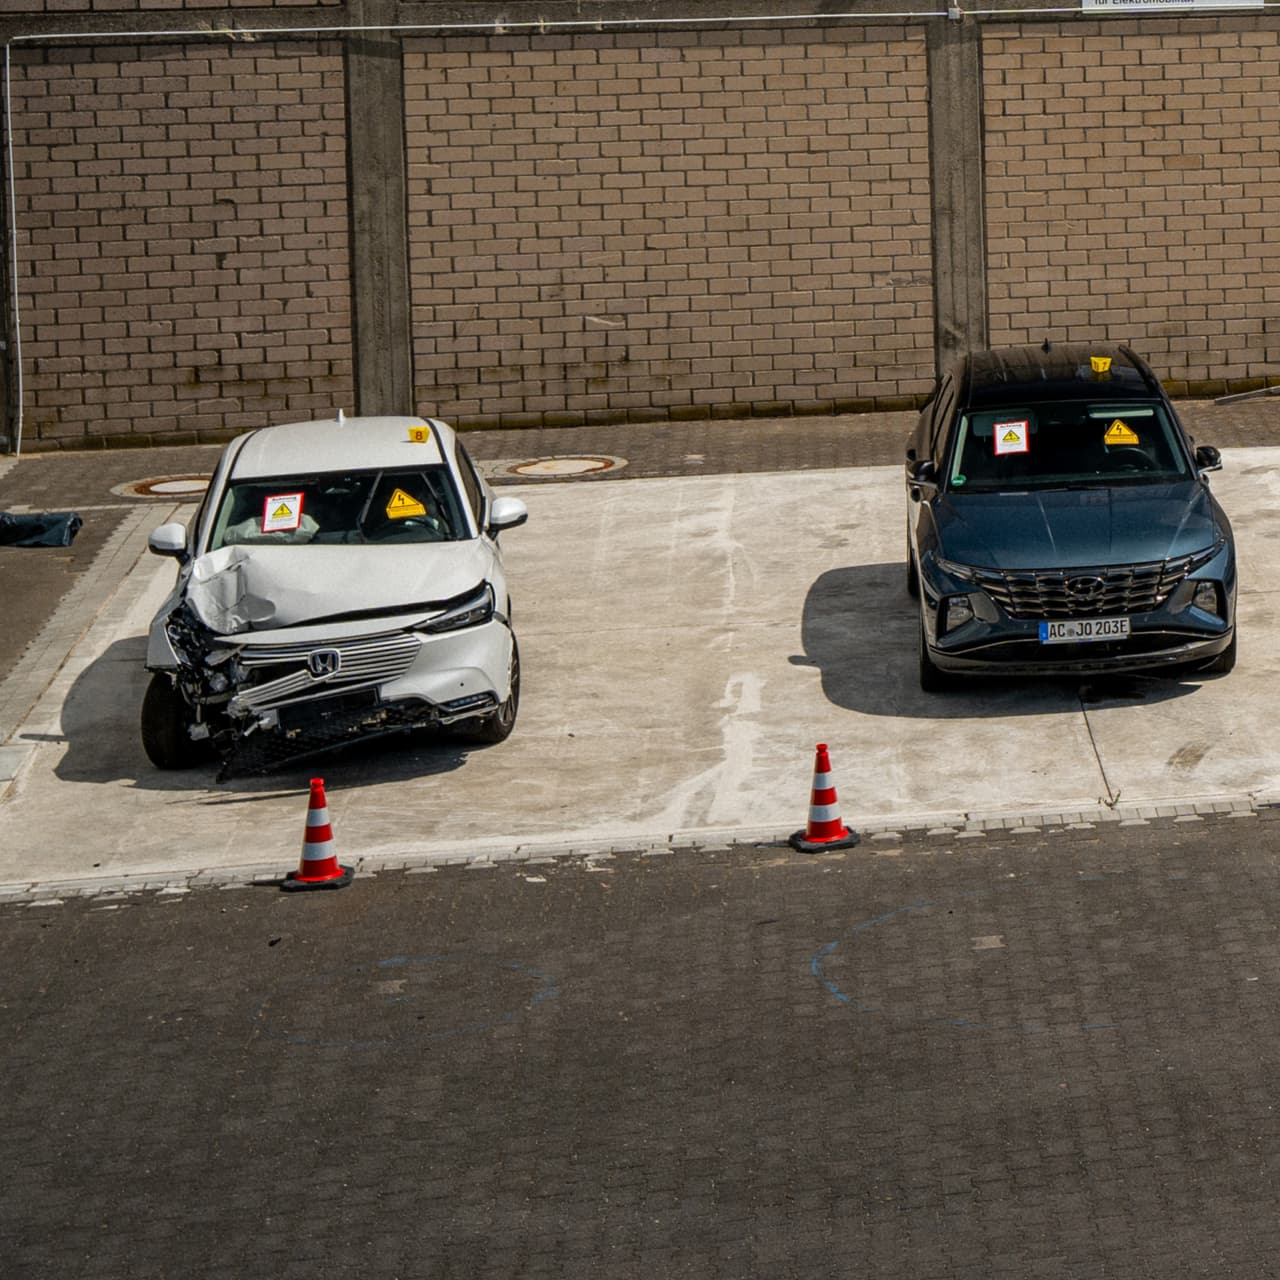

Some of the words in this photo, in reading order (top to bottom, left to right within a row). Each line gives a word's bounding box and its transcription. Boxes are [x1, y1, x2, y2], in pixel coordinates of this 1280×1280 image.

[415, 431, 423, 440] 8
[1049, 623, 1066, 638] AC
[1095, 619, 1129, 635] 203E
